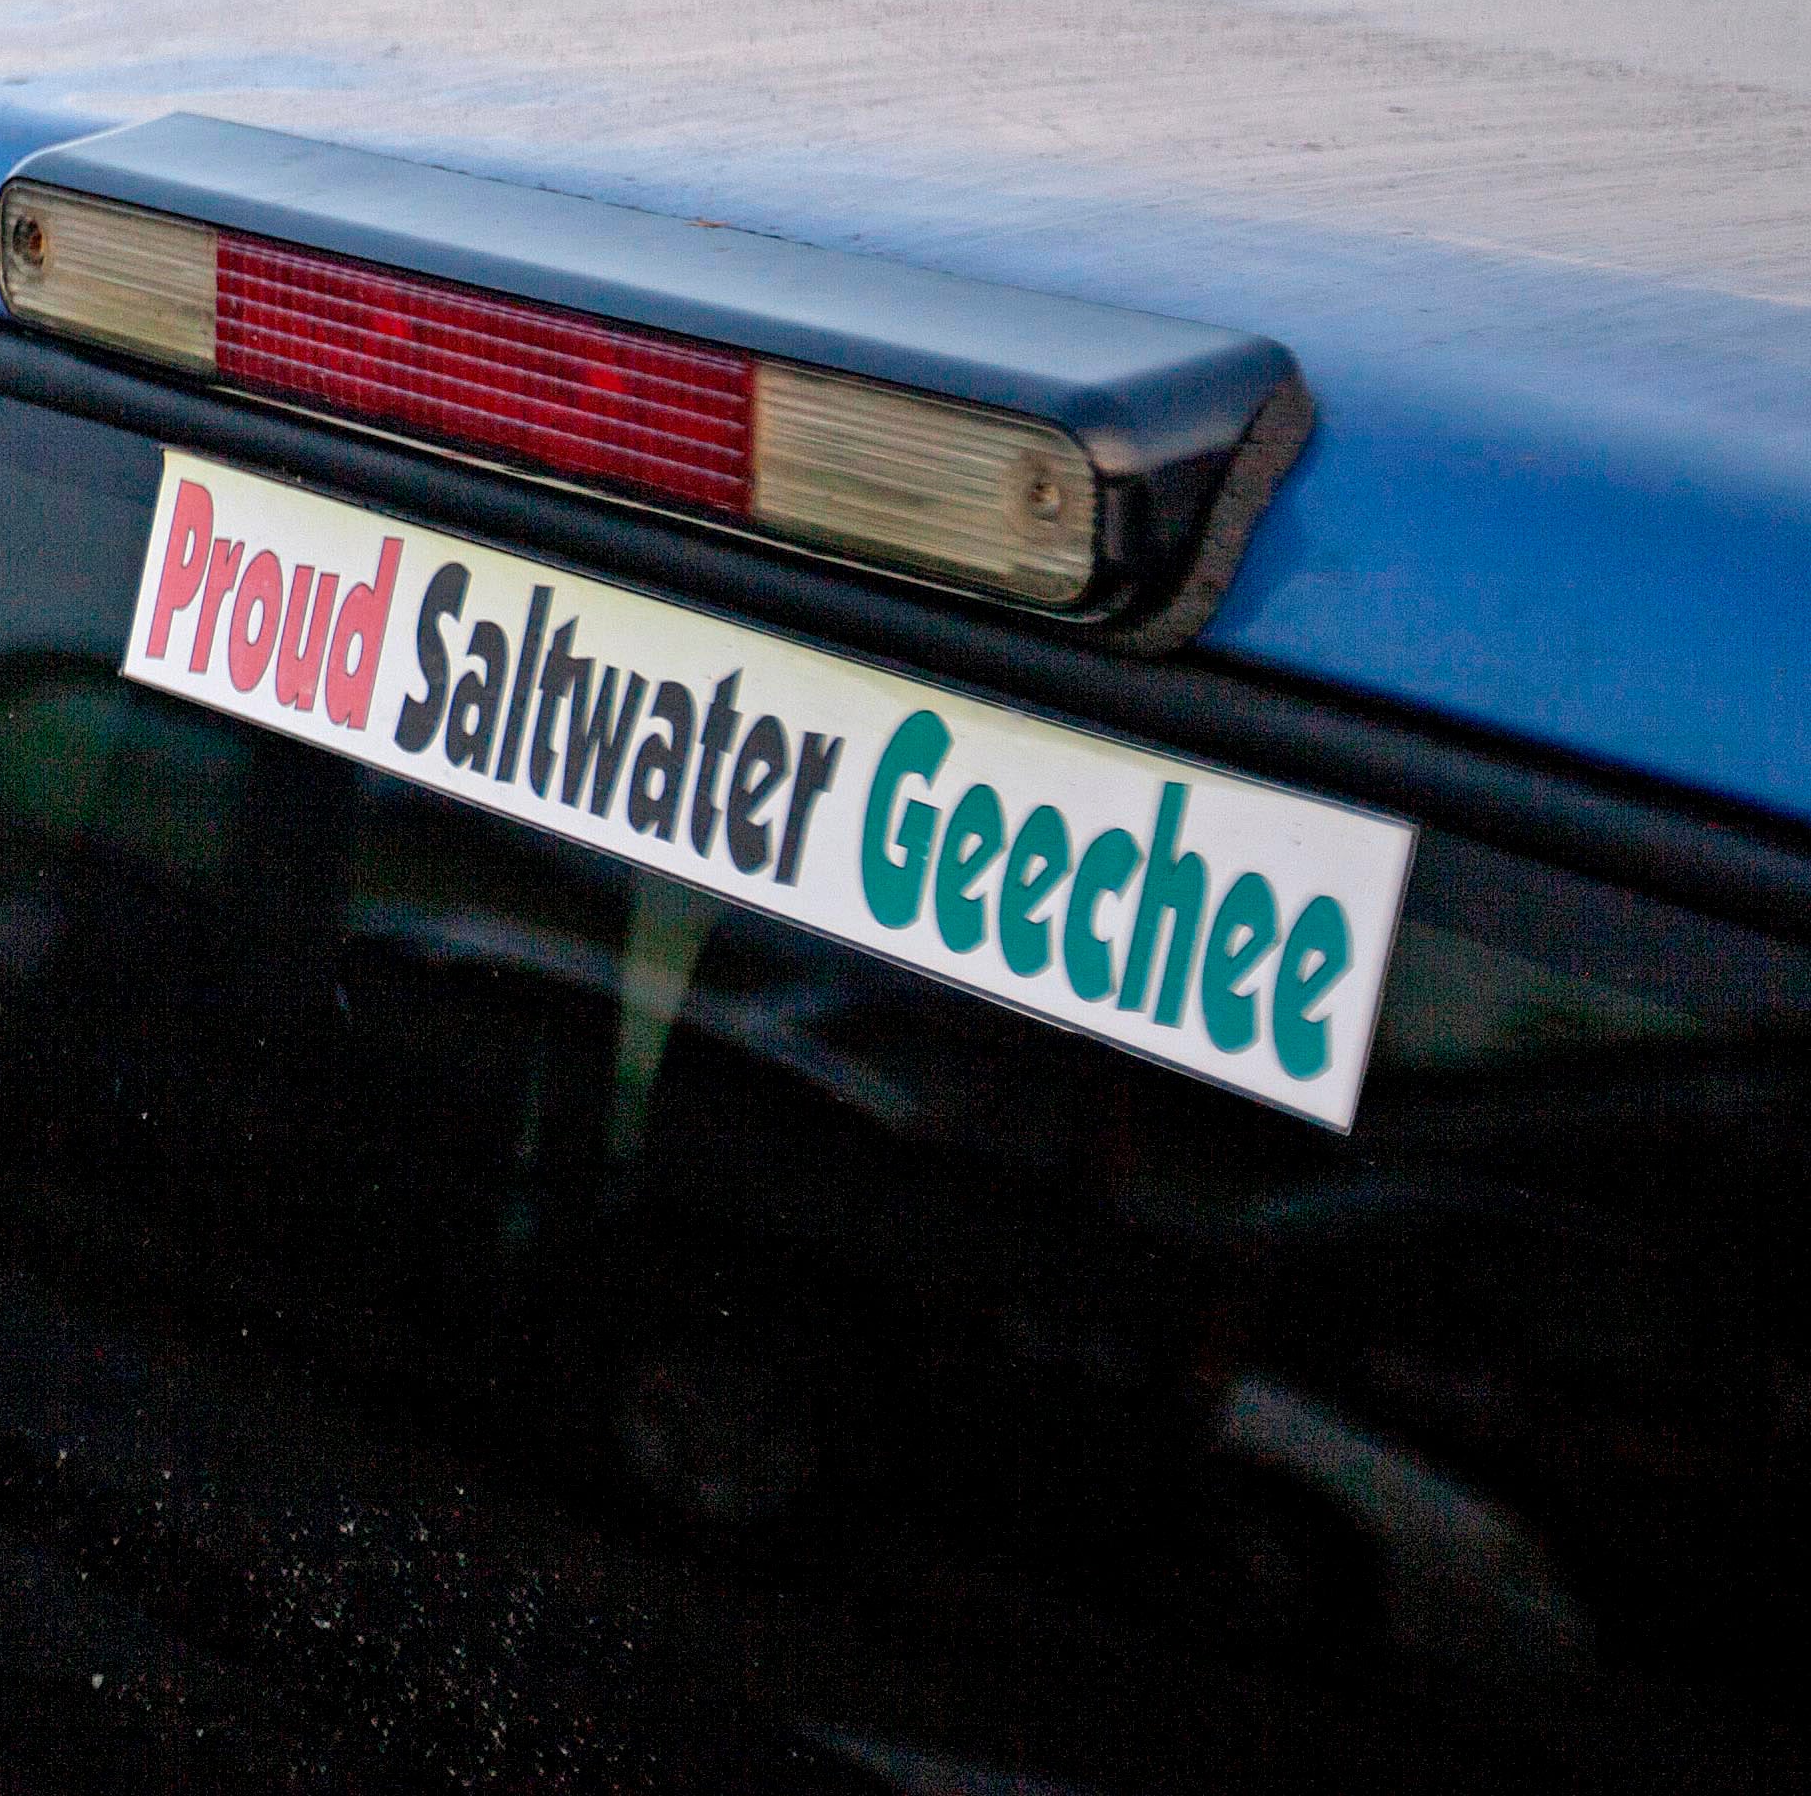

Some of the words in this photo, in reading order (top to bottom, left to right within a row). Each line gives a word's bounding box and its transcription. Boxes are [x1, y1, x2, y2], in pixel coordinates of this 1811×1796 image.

[146, 479, 398, 729] Proud
[395, 562, 843, 887] Saltwater
[861, 710, 1351, 1080] Geechee
